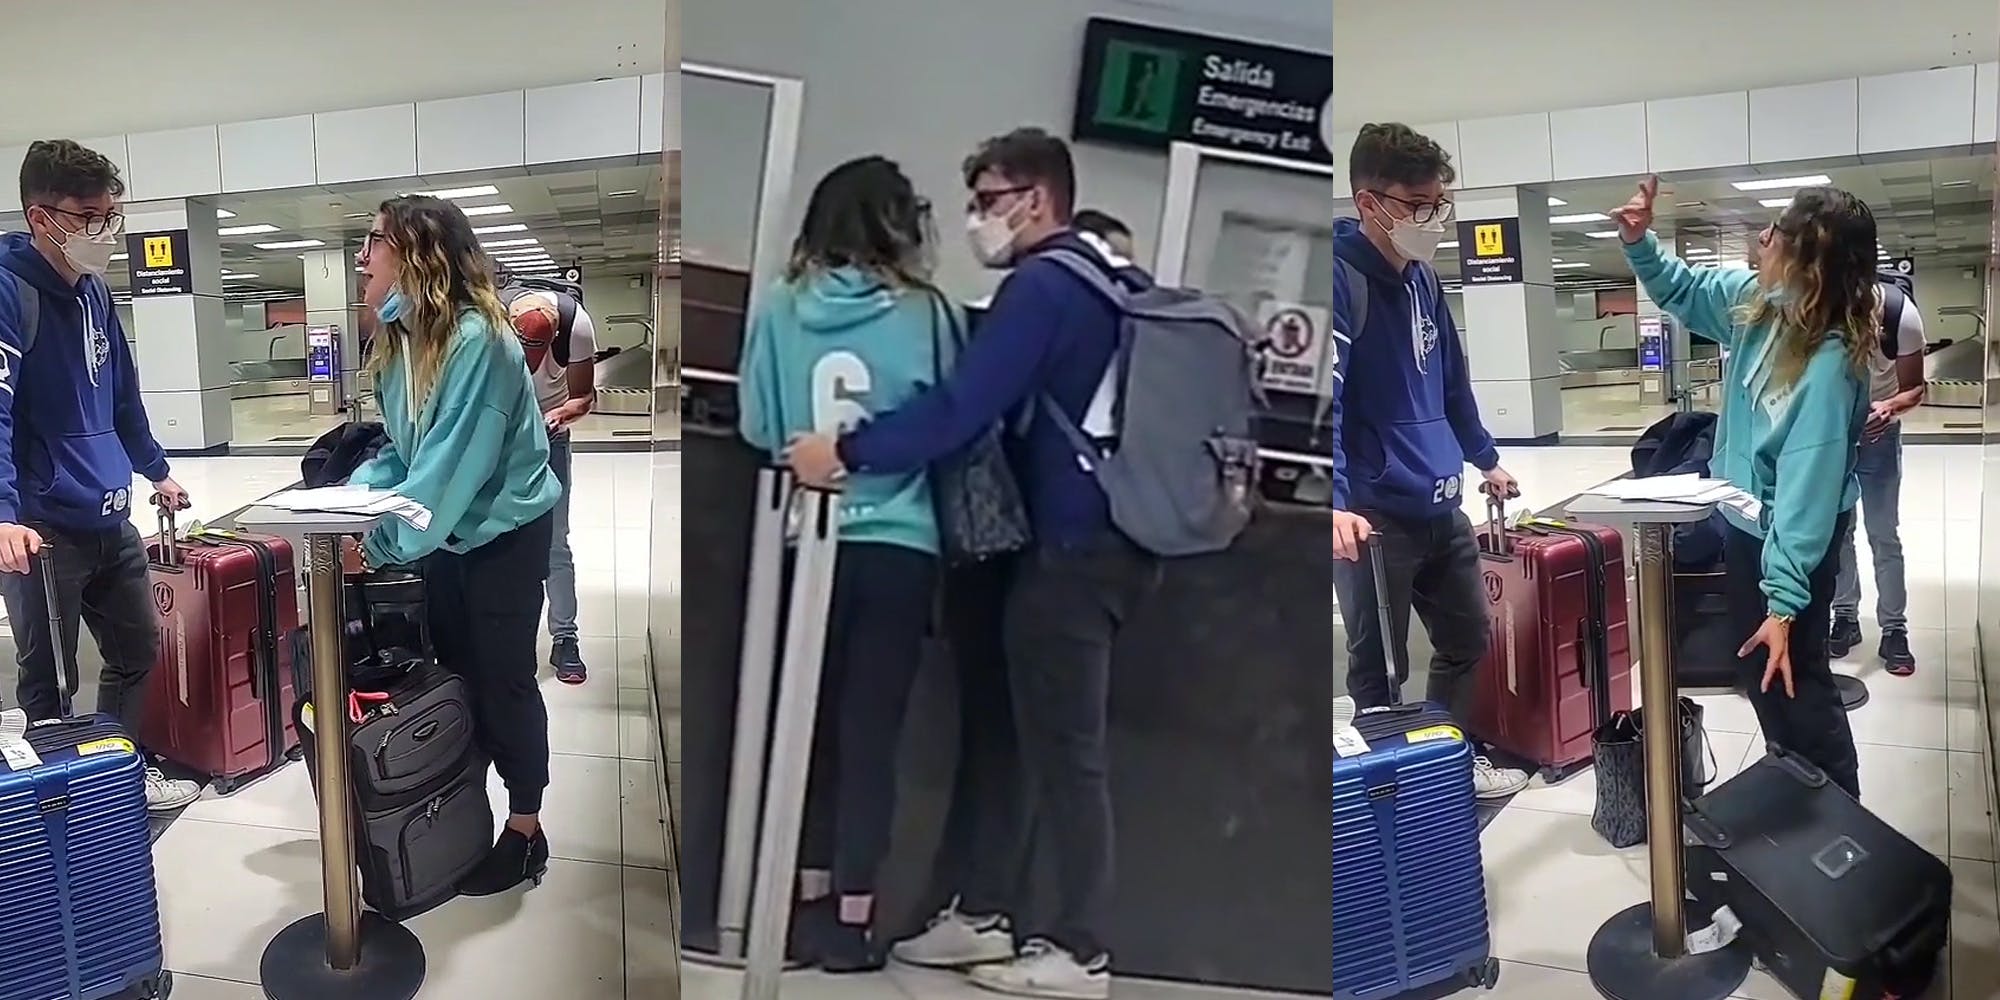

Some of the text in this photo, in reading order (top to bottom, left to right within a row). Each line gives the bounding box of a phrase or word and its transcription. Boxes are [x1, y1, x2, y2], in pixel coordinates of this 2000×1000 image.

[1203, 55, 1275, 88] Salida
[1198, 85, 1315, 122] Emergencias
[1191, 117, 1311, 151] Emergency Exit
